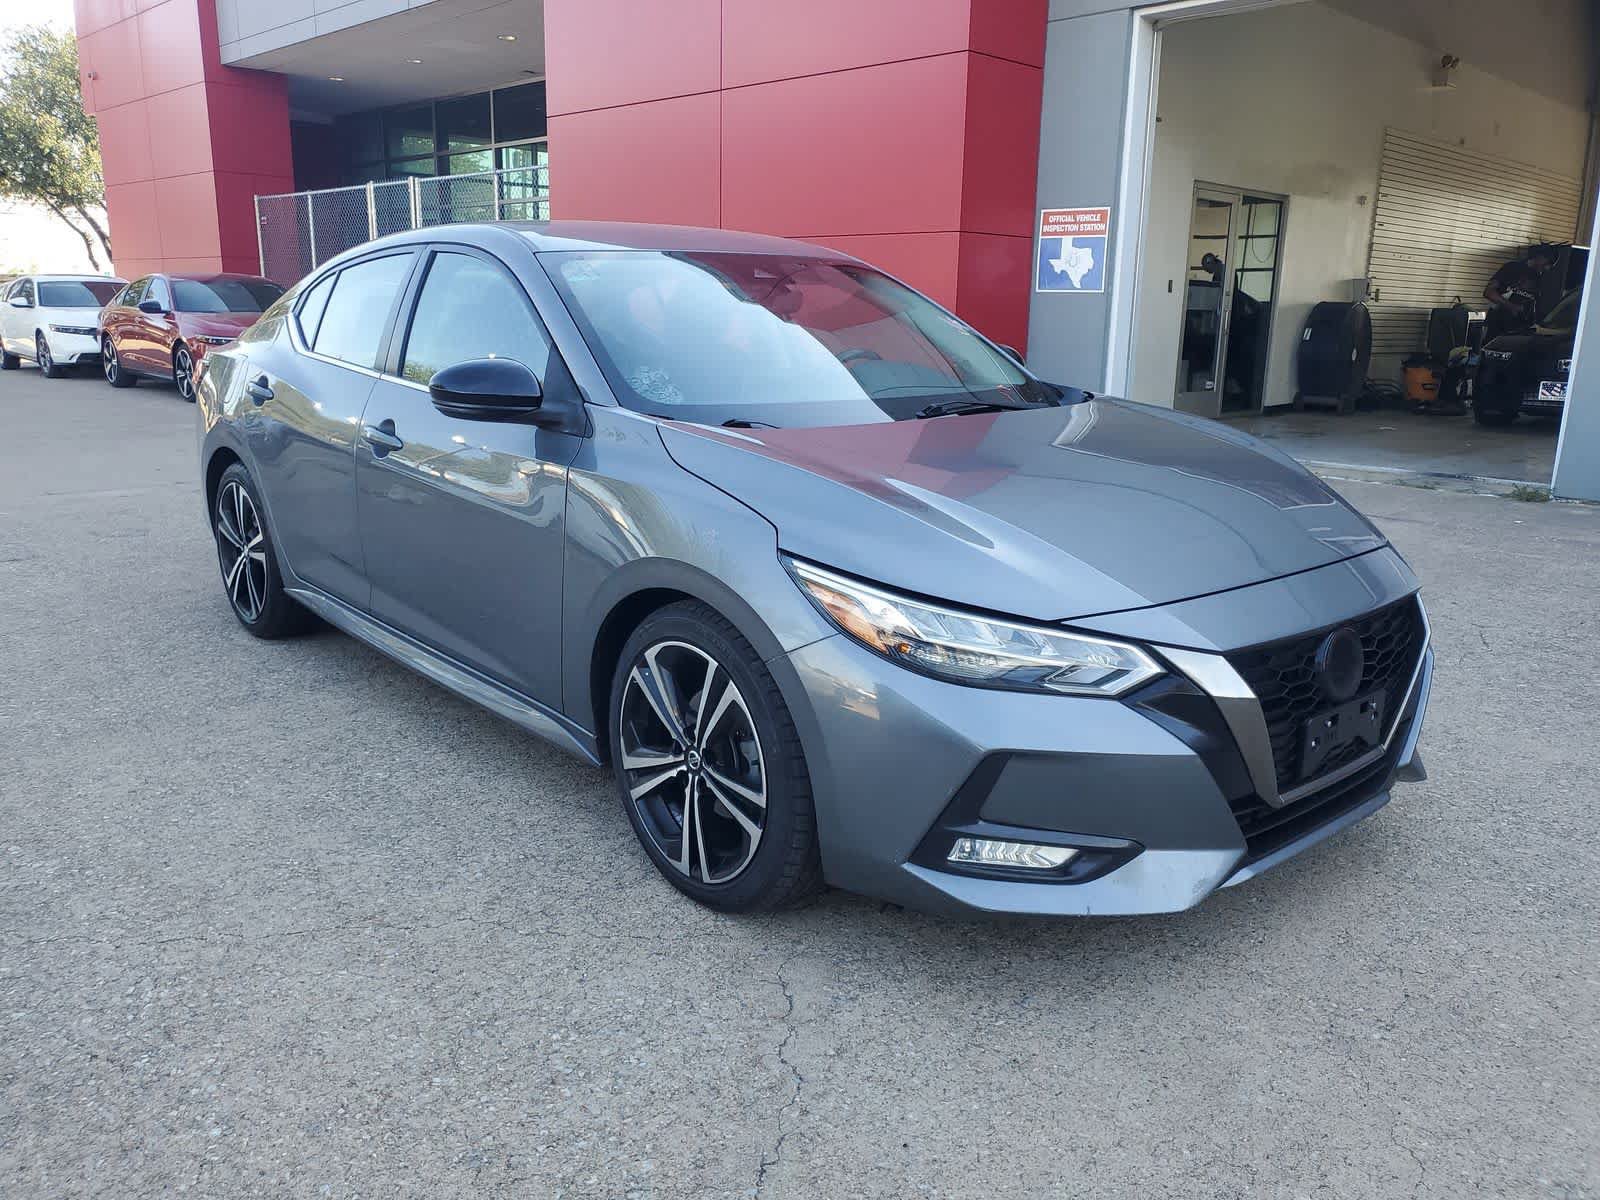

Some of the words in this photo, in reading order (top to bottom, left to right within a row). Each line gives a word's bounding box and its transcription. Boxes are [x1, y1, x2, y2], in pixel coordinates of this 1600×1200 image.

[1076, 214, 1101, 222] VEHICLE
[1043, 224, 1078, 232] INSPECTION
[1080, 223, 1105, 232] STATION
